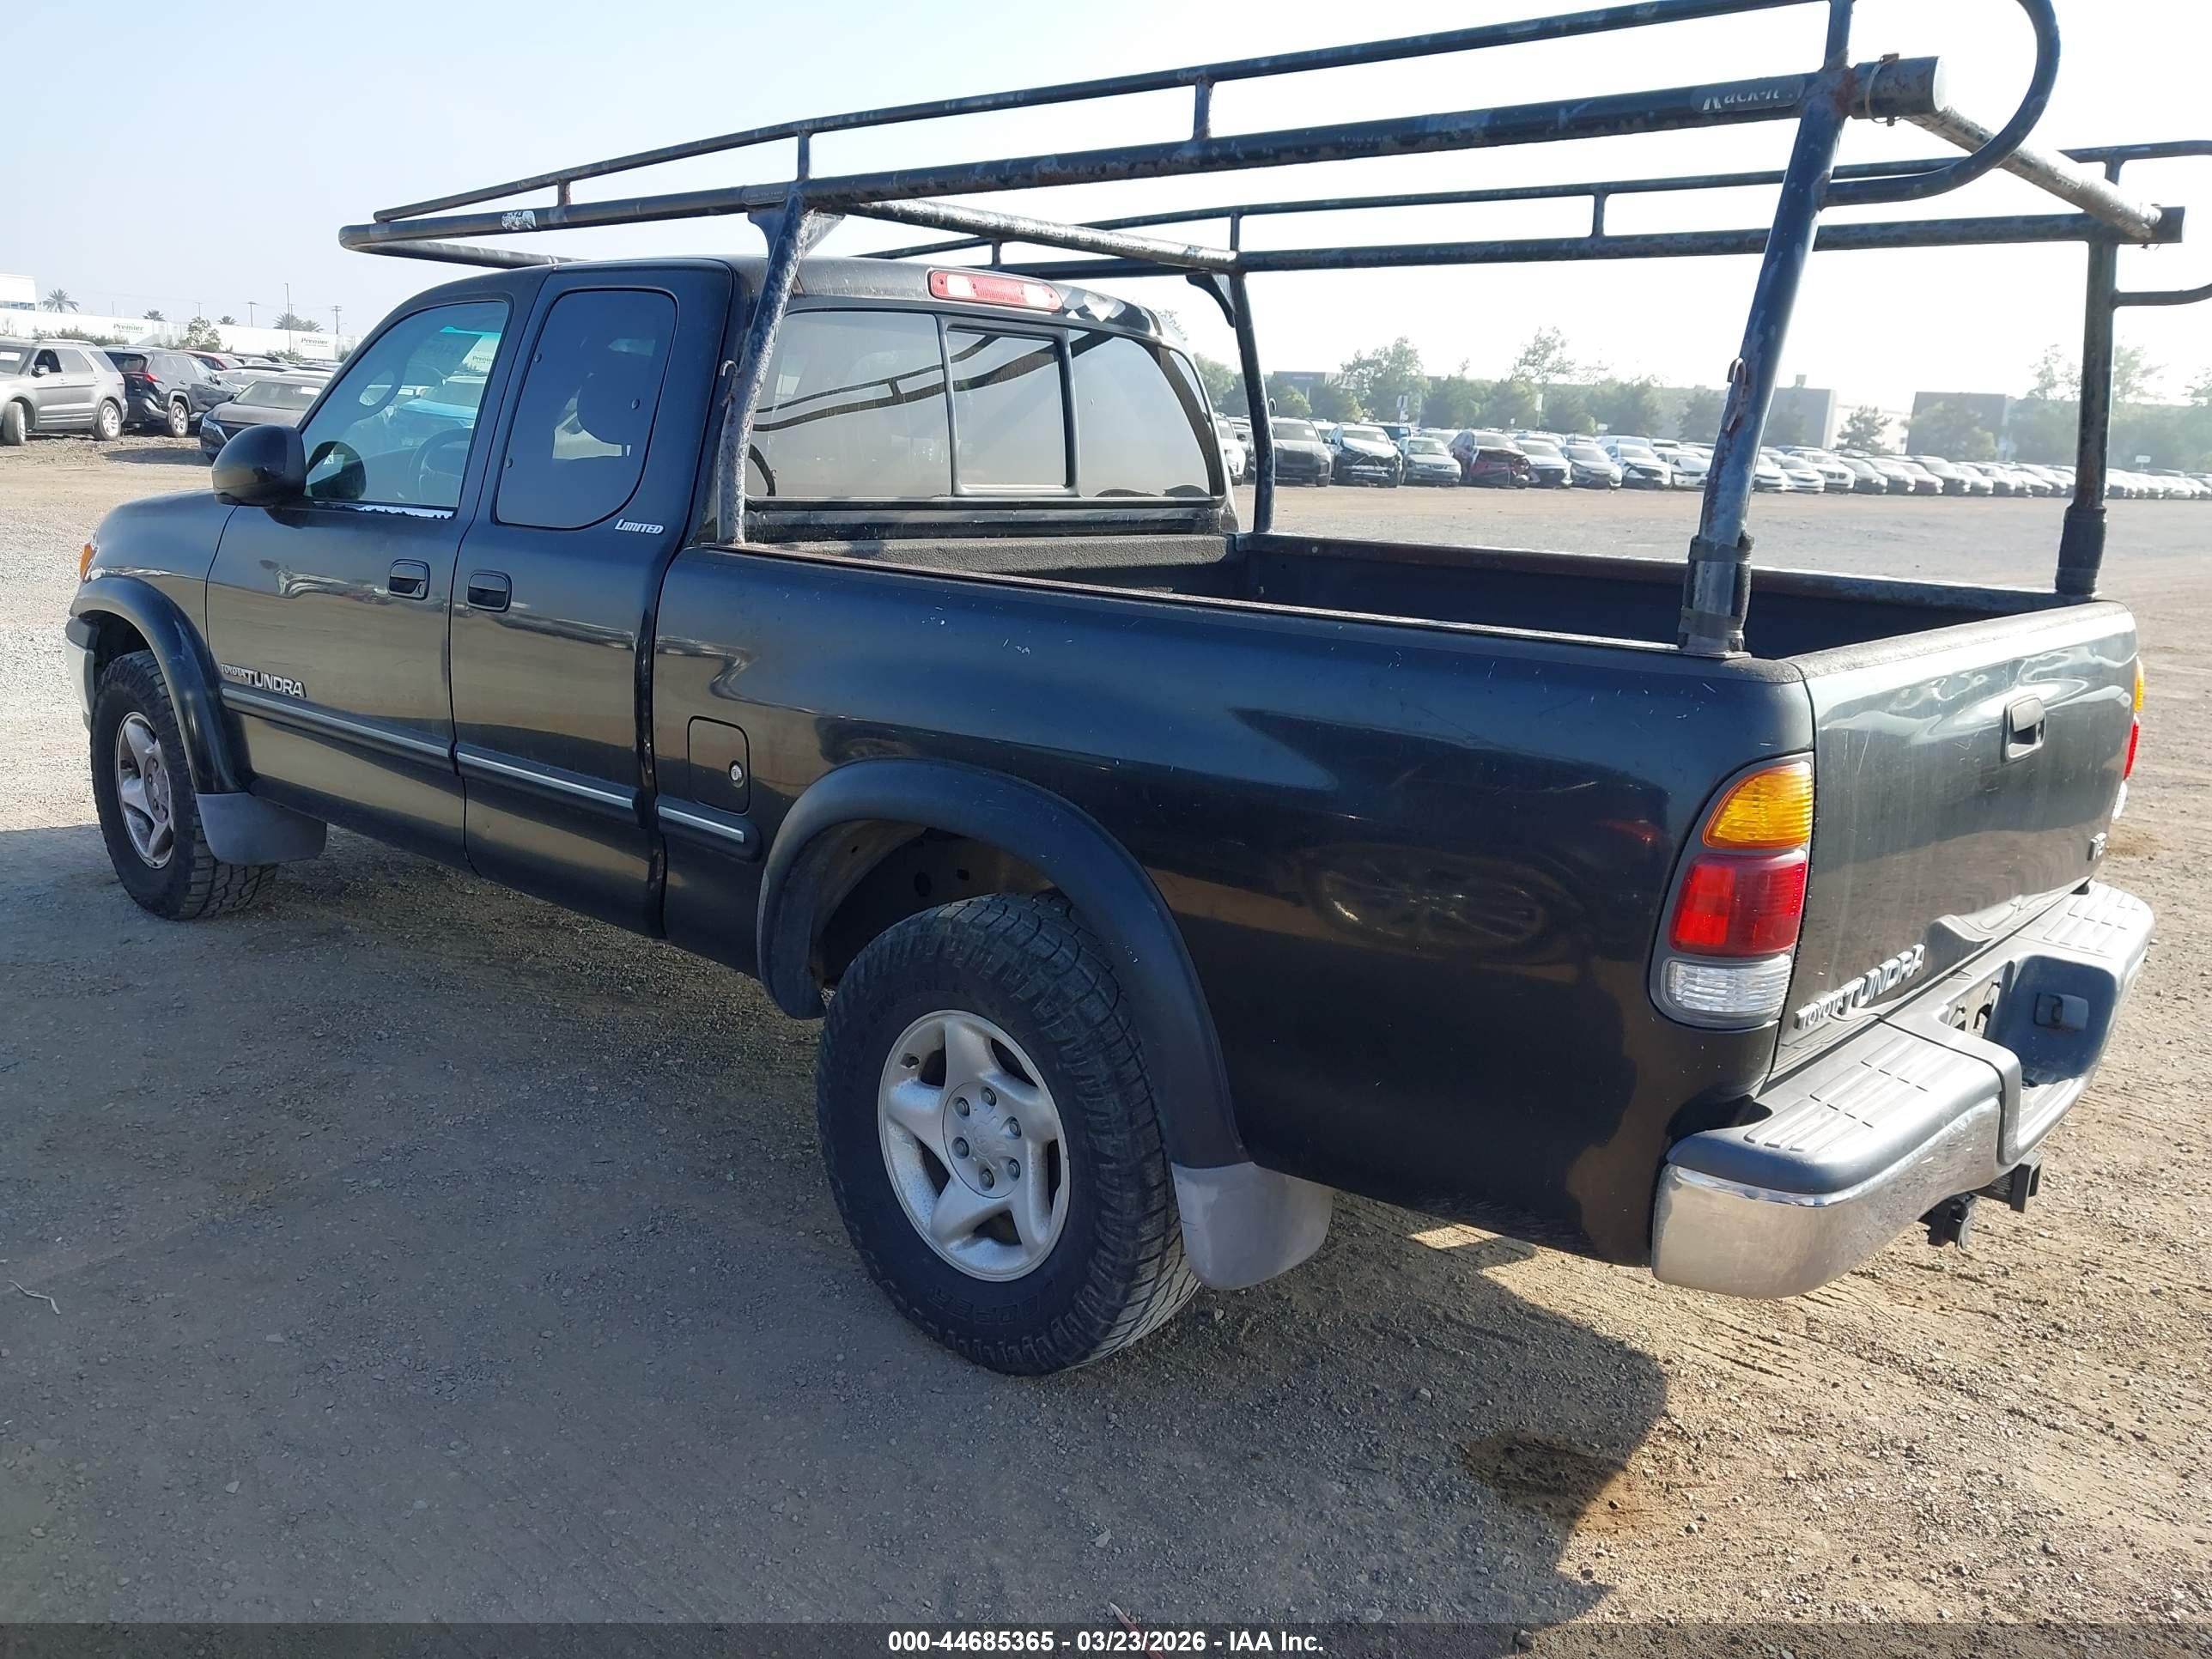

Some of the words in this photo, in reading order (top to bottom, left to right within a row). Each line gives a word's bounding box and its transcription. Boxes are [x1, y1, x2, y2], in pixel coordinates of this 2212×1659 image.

[220, 664, 246, 678] TOYOTA
[244, 670, 306, 697] TUNDRA
[1794, 989, 1844, 1030] TOYOTA
[1841, 944, 1925, 1016] TUNDRA
